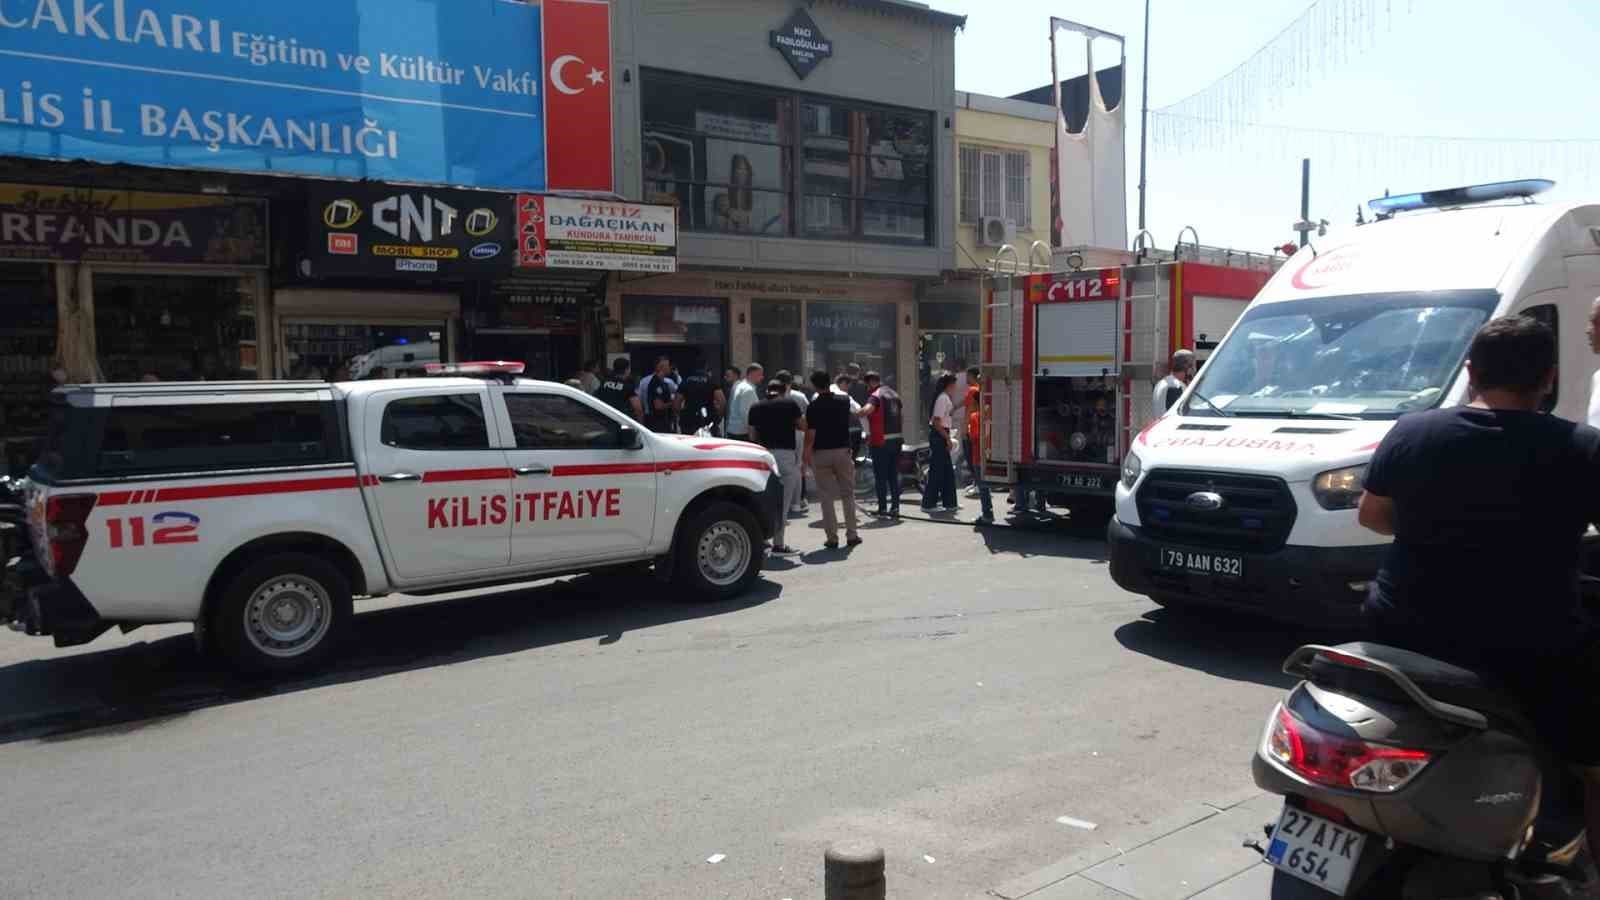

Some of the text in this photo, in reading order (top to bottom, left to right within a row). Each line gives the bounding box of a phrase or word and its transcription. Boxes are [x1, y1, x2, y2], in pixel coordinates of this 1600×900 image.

[232, 31, 327, 67] Eğitim
[338, 53, 371, 74] ve
[379, 51, 465, 85] Kültür
[473, 63, 538, 96] Vakfı
[83, 87, 124, 133] İL
[140, 103, 399, 159] BAŞKANLIĞI
[1, 212, 193, 248] RFANDA
[371, 193, 458, 243] CNT
[399, 259, 436, 271] iPhone
[1064, 278, 1102, 299] 112
[105, 510, 200, 548] 112
[1167, 550, 1240, 575] 79 AAN 632
[1282, 811, 1360, 860] 27 ATK
[1287, 849, 1329, 882] 654
